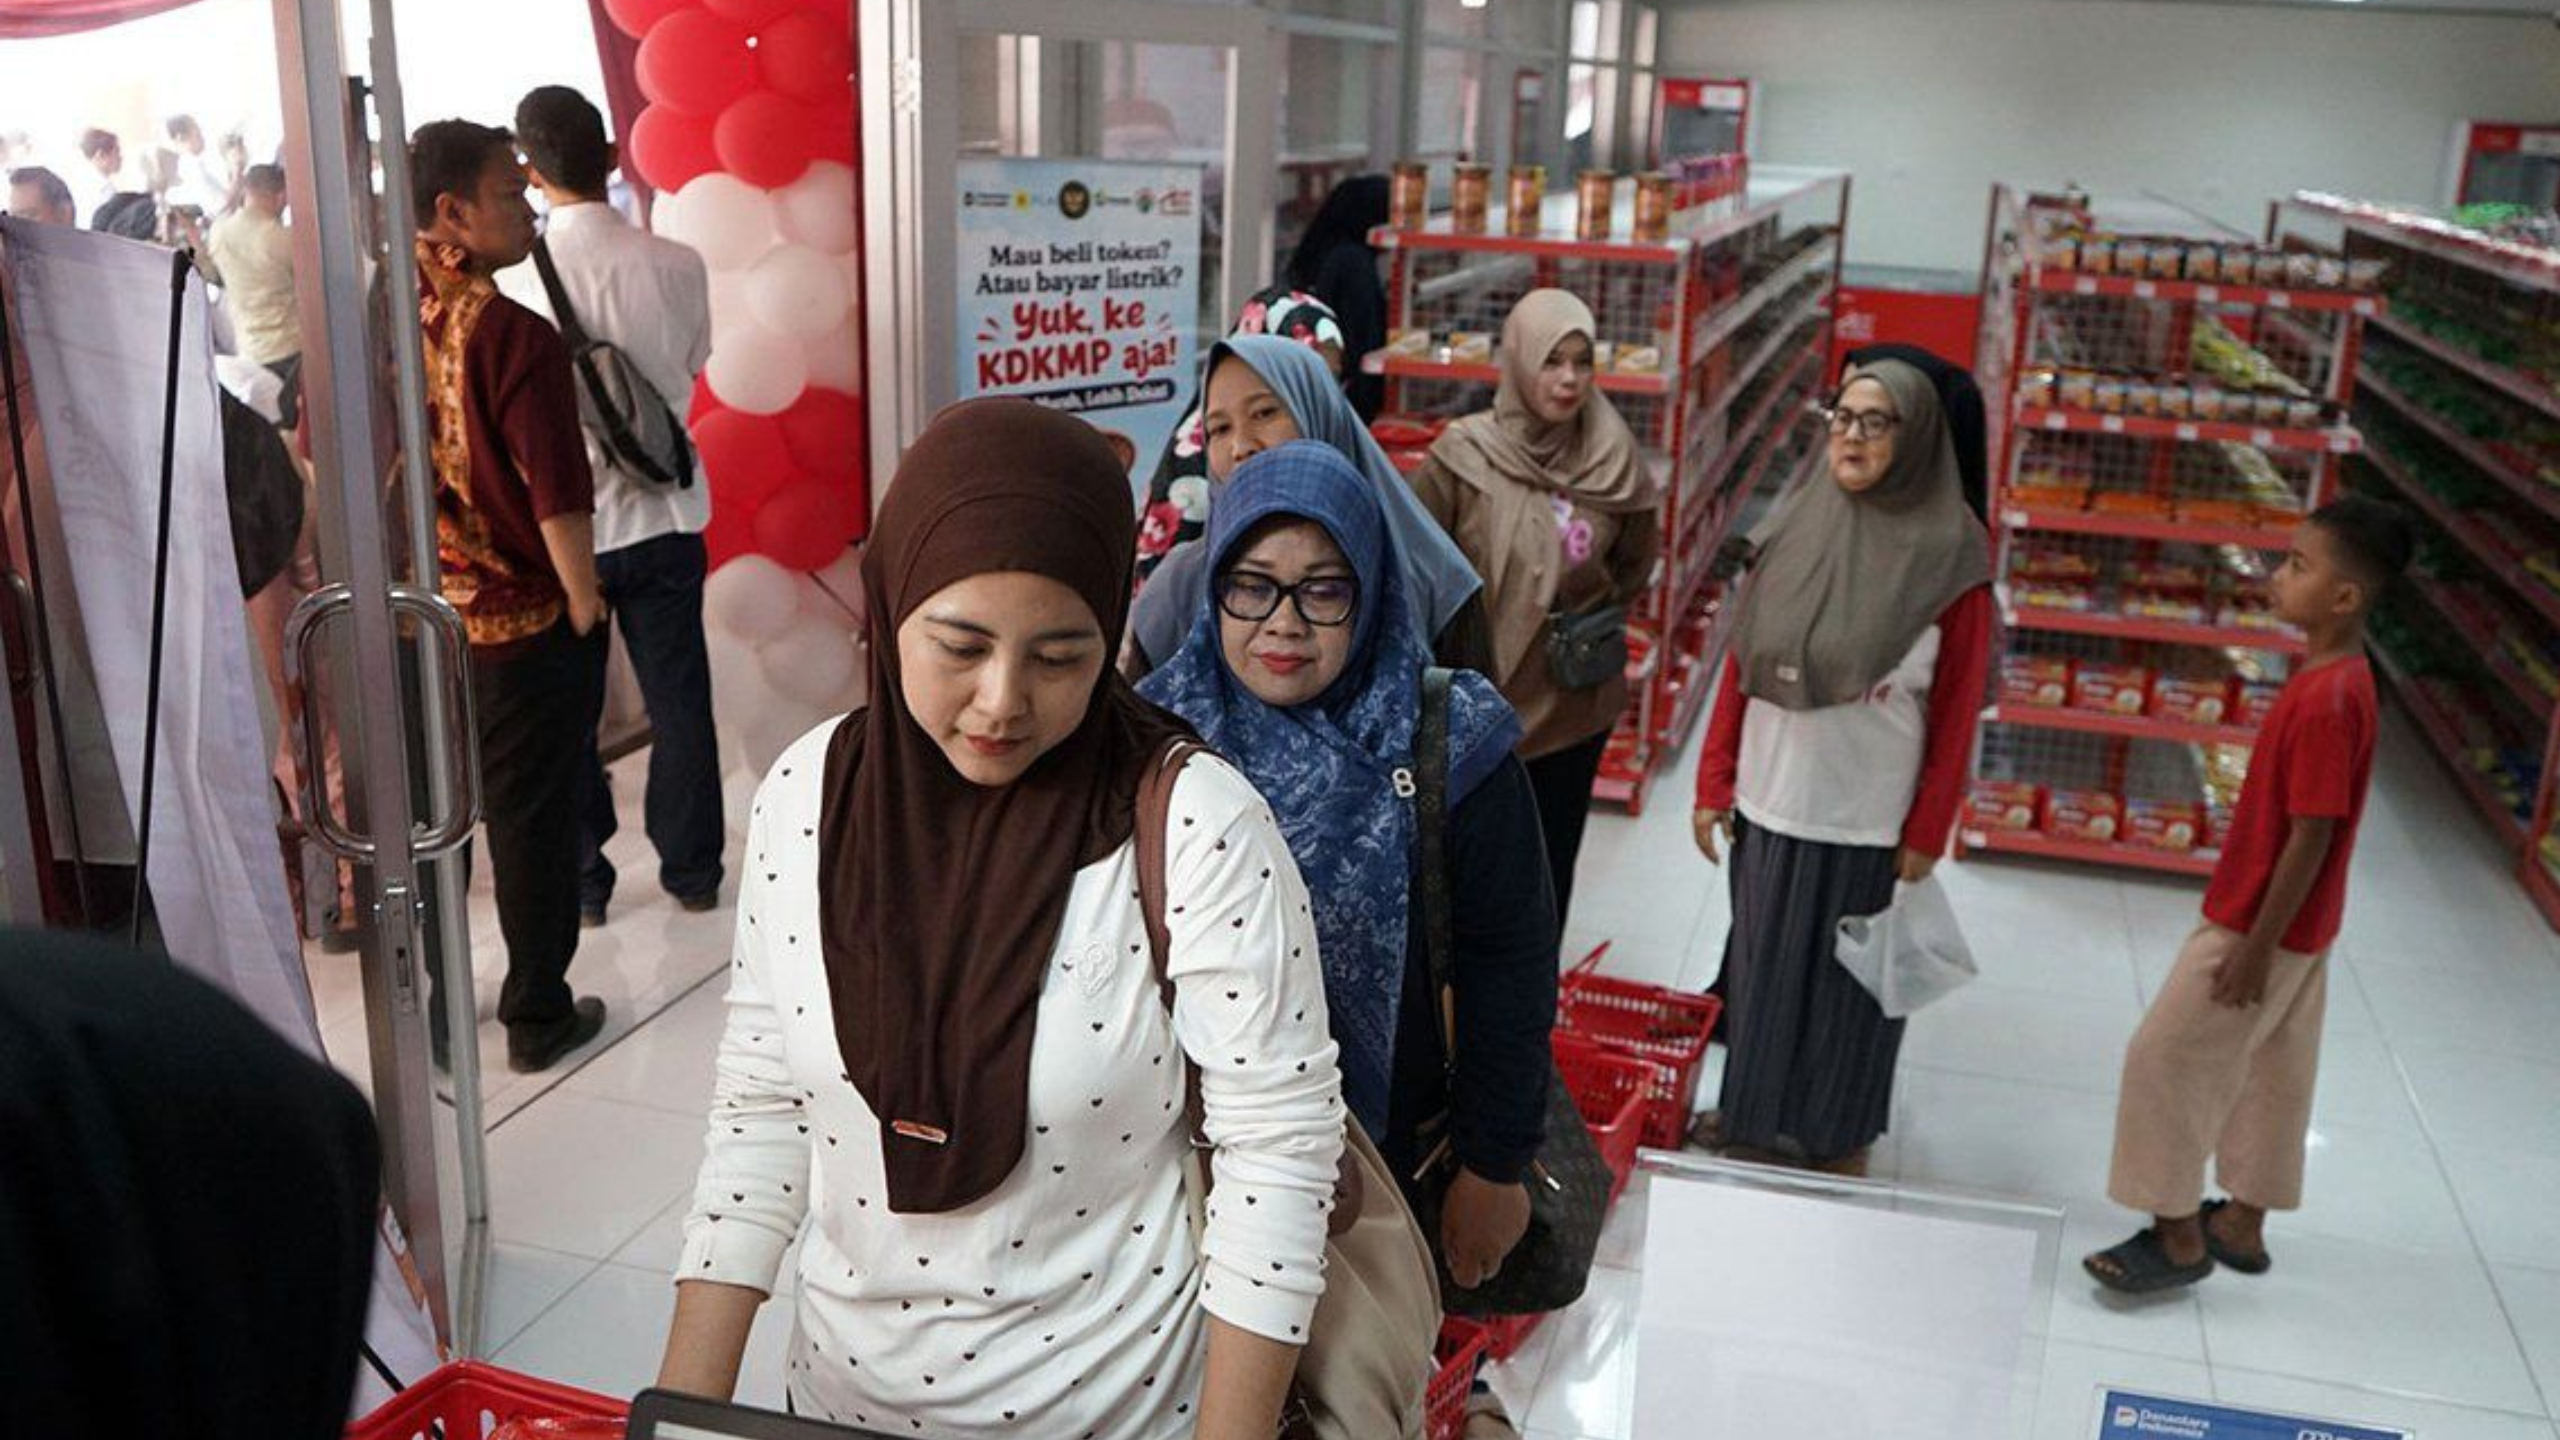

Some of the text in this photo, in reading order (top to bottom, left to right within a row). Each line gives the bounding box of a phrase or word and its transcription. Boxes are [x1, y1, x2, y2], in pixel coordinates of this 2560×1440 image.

[990, 240, 1172, 267] Mau beli token?
[976, 266, 1183, 296] Atau bayar listrik?
[1013, 297, 1145, 341] Yuk, ke
[977, 336, 1177, 389] KDKMP aja!
[2140, 1408, 2210, 1429] Danantara
